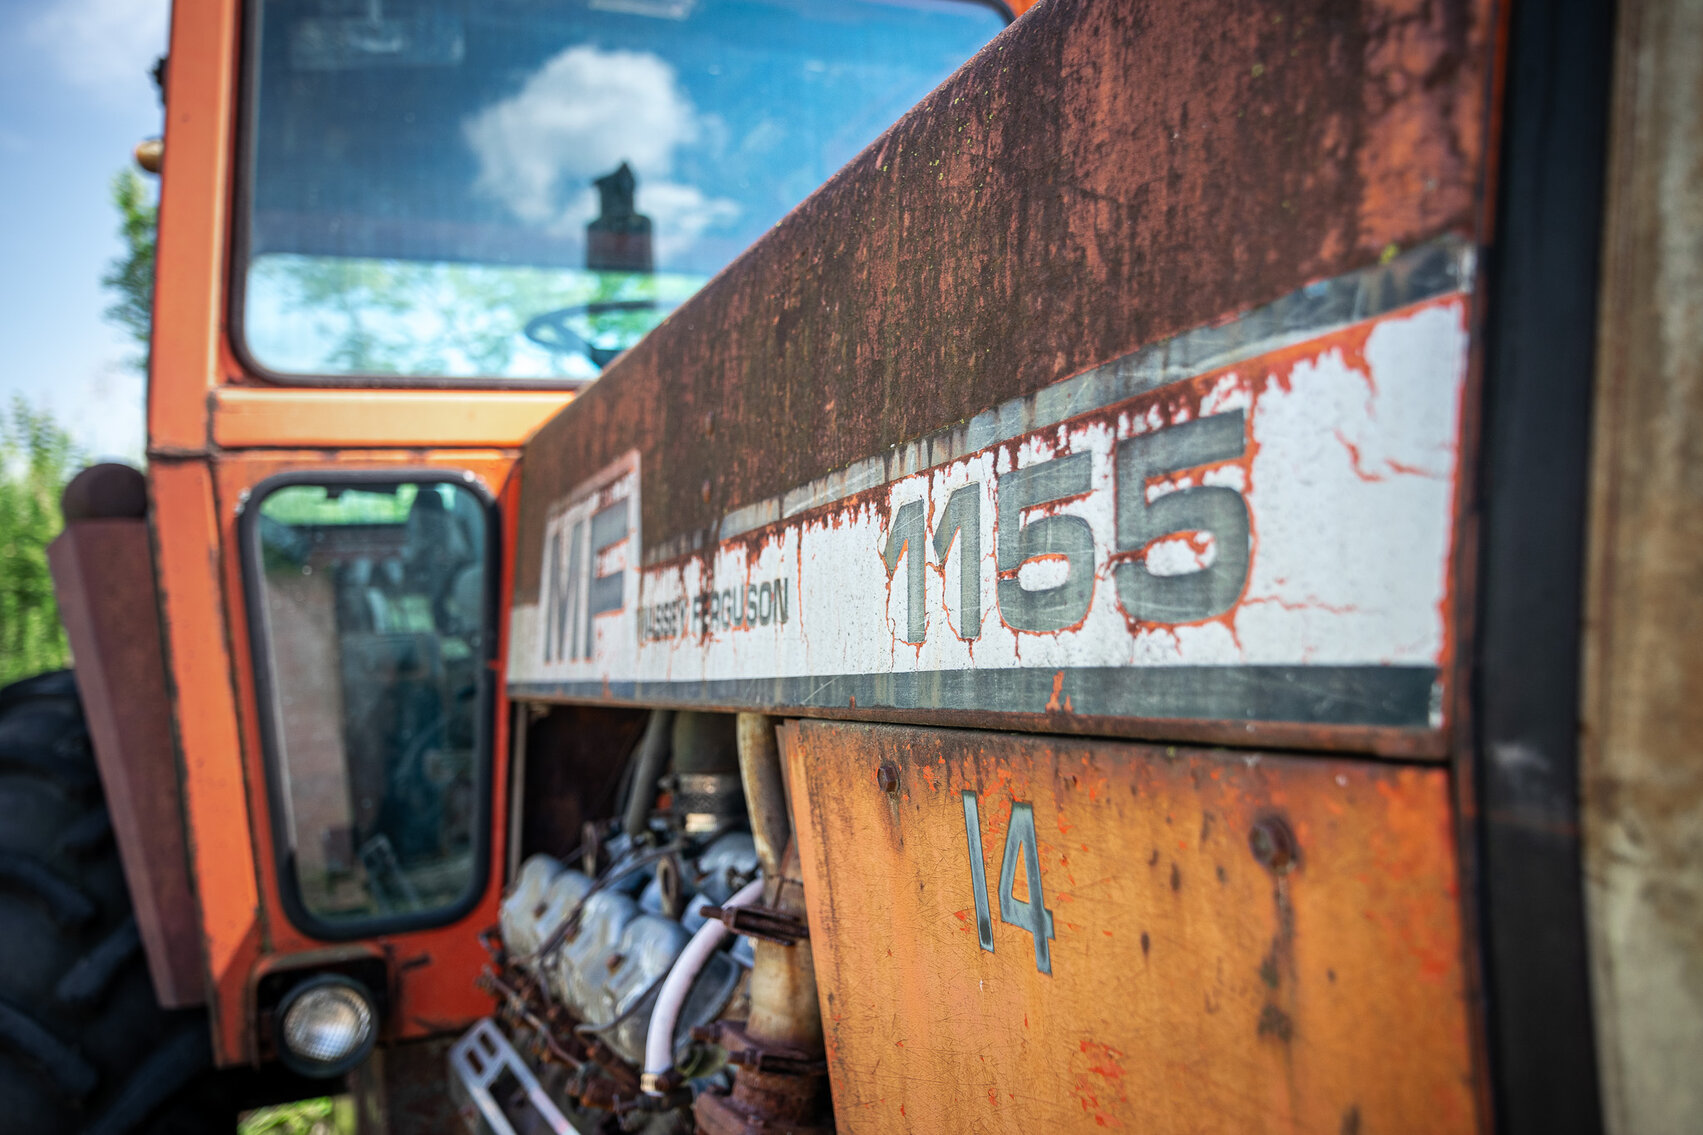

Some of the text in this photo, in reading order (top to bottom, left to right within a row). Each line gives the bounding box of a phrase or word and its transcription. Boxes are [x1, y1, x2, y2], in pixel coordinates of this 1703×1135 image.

[545, 496, 629, 663] MF
[883, 409, 1250, 643] 1155
[962, 790, 1055, 977] 14
